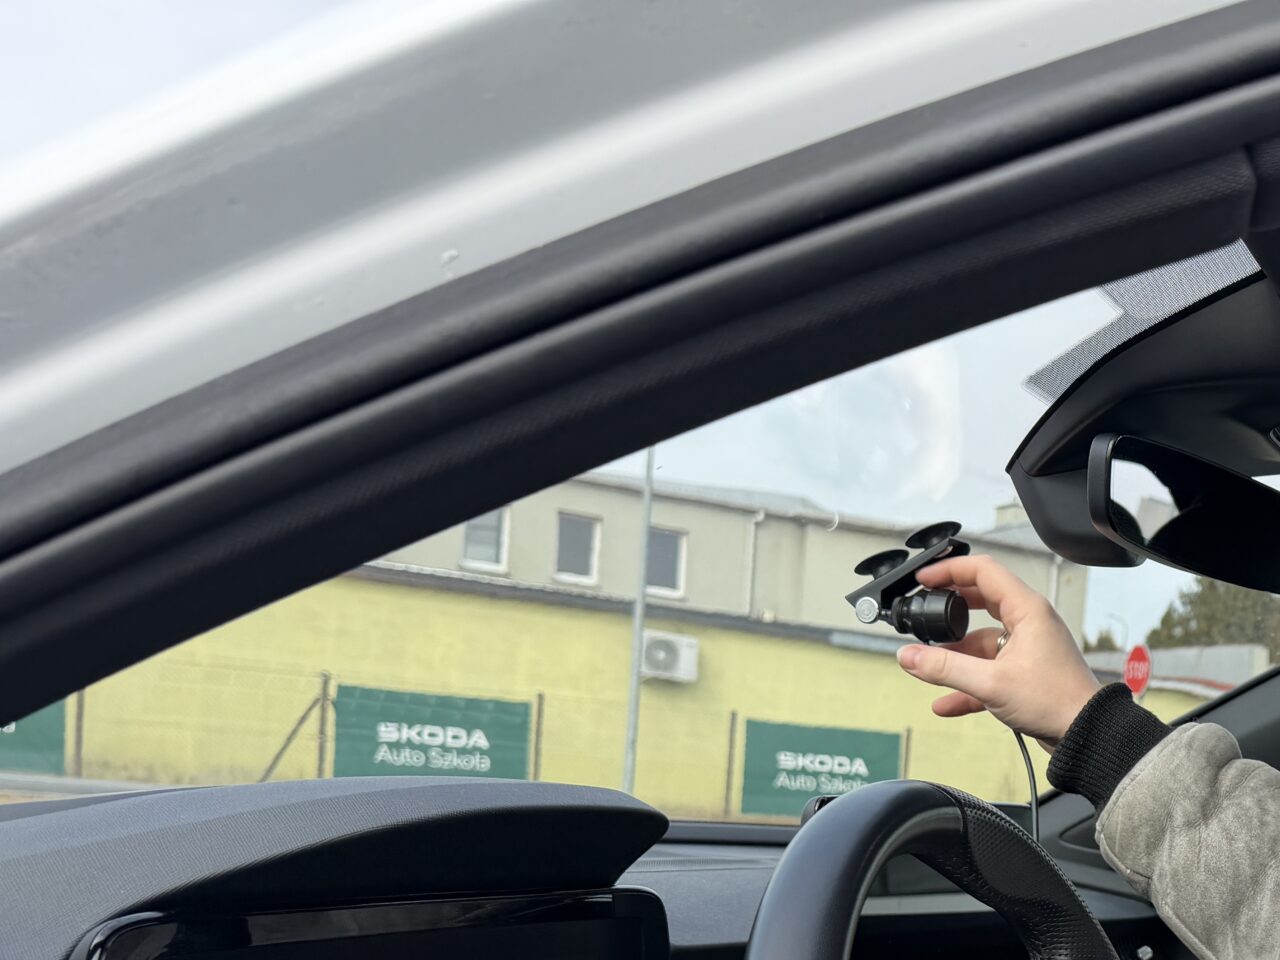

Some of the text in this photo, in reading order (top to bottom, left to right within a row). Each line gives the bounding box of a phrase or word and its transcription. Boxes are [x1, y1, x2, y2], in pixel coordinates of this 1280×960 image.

[1126, 660, 1149, 679] STOP
[374, 744, 425, 766] Auto
[774, 771, 817, 792] Auto
